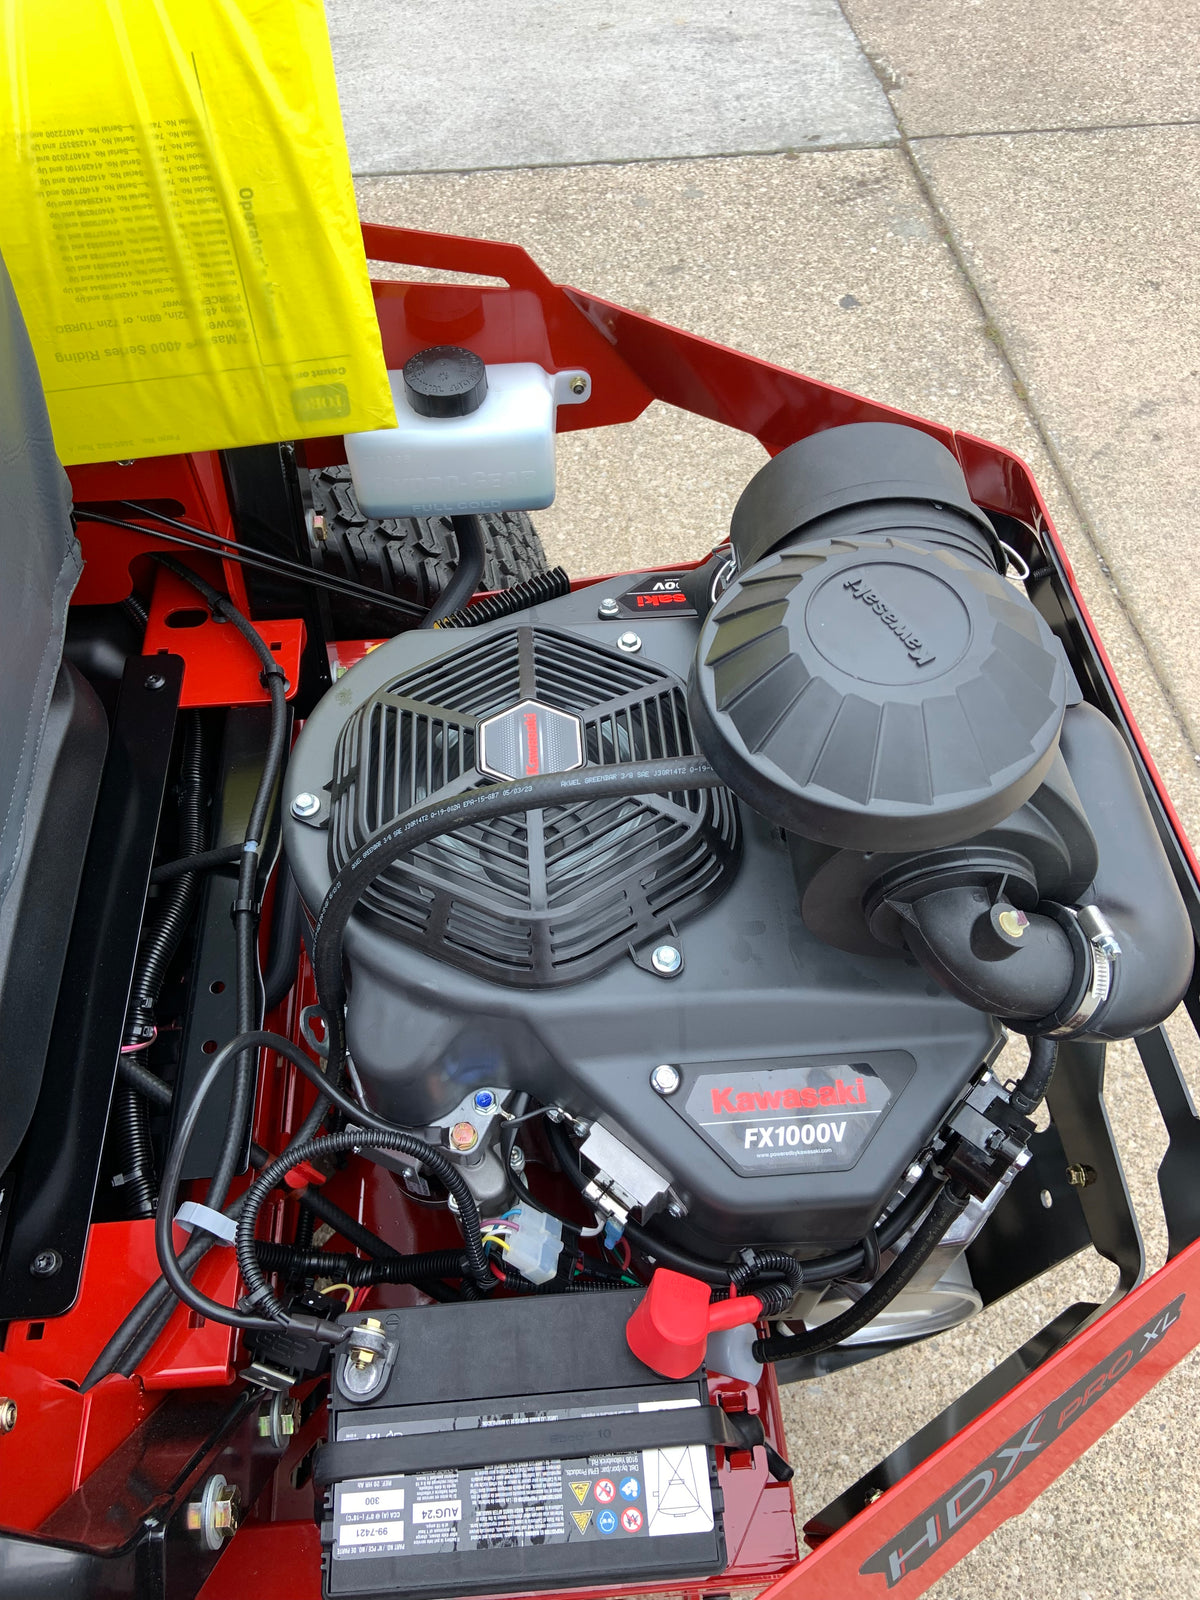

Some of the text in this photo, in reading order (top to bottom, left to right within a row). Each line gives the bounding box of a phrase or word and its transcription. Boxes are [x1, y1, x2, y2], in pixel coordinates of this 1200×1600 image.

[42, 142, 55, 150] and
[39, 177, 50, 186] Up
[54, 320, 94, 335] TURBO
[150, 339, 182, 354] 4000
[54, 346, 99, 366] Riding
[636, 592, 686, 608] saki
[843, 578, 936, 668] Kawasaki
[523, 713, 538, 774] Kawasaki
[711, 1077, 868, 1114] Kawasaki
[744, 1122, 847, 1149] FX1000V
[756, 1147, 832, 1158] www.poweredbykawasaki.com
[888, 1312, 1178, 1581] HDX PRO XL
[364, 1496, 379, 1505] 300
[421, 1506, 458, 1519] AUG'24
[356, 1526, 388, 1537] 99-7421
